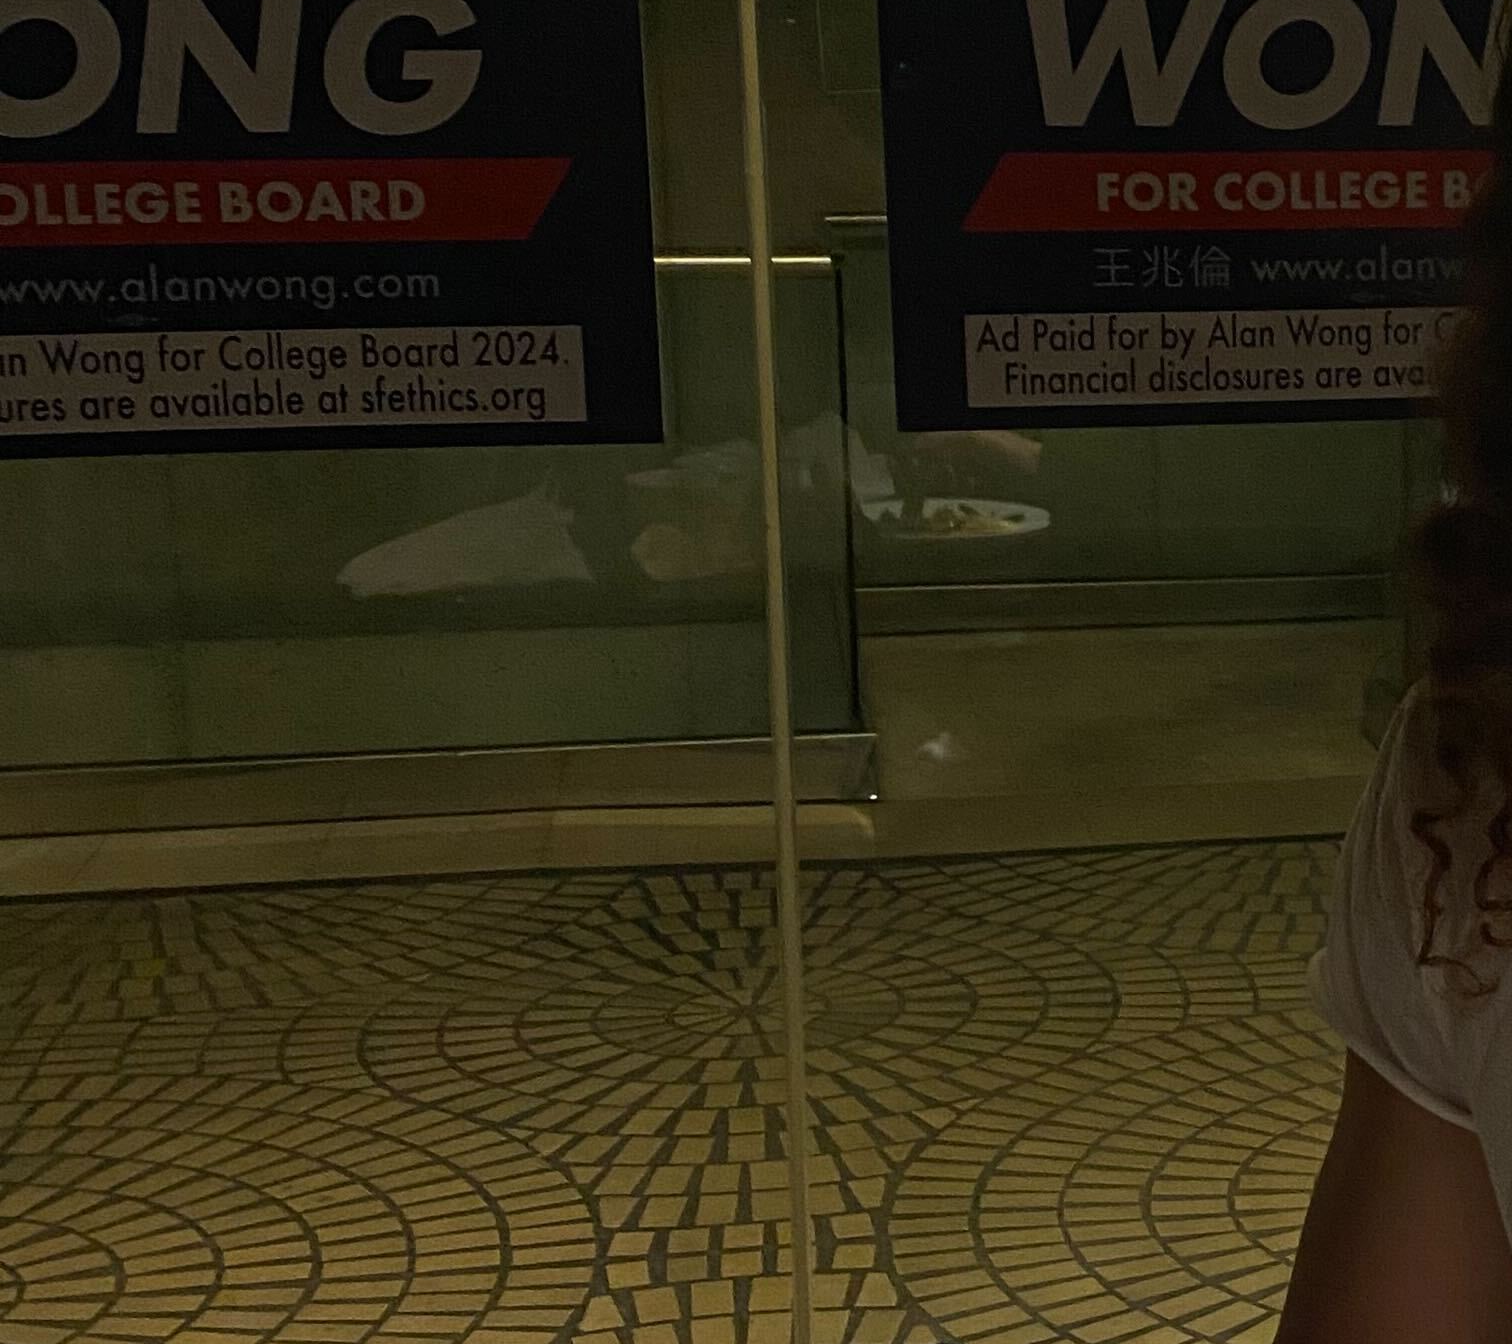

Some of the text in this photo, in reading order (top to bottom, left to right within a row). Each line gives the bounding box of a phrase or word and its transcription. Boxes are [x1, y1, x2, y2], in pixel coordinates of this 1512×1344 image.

[0, 179, 426, 226] OLLEGE BOARD
[1096, 171, 1199, 213] FOR
[1213, 169, 1428, 213] COLLEGE
[1093, 244, 1232, 290] 王兆倫
[39, 339, 145, 384] Wong
[159, 334, 205, 371] for
[219, 332, 348, 380] College
[361, 328, 460, 369] Board
[473, 330, 571, 368] 2024.
[976, 318, 1020, 354] Ad
[1033, 315, 1095, 353] Paid
[1107, 316, 1149, 352] for
[1161, 313, 1196, 359] by
[1208, 315, 1275, 348] Alan
[1286, 314, 1372, 355] Wong
[1384, 310, 1423, 345] for
[1005, 358, 1136, 395] Financial
[1149, 357, 1304, 393] disclosures
[1315, 365, 1362, 389] are
[80, 395, 136, 422] are
[150, 381, 304, 420] available
[319, 386, 349, 416] at
[361, 378, 546, 421] sfethics.org
